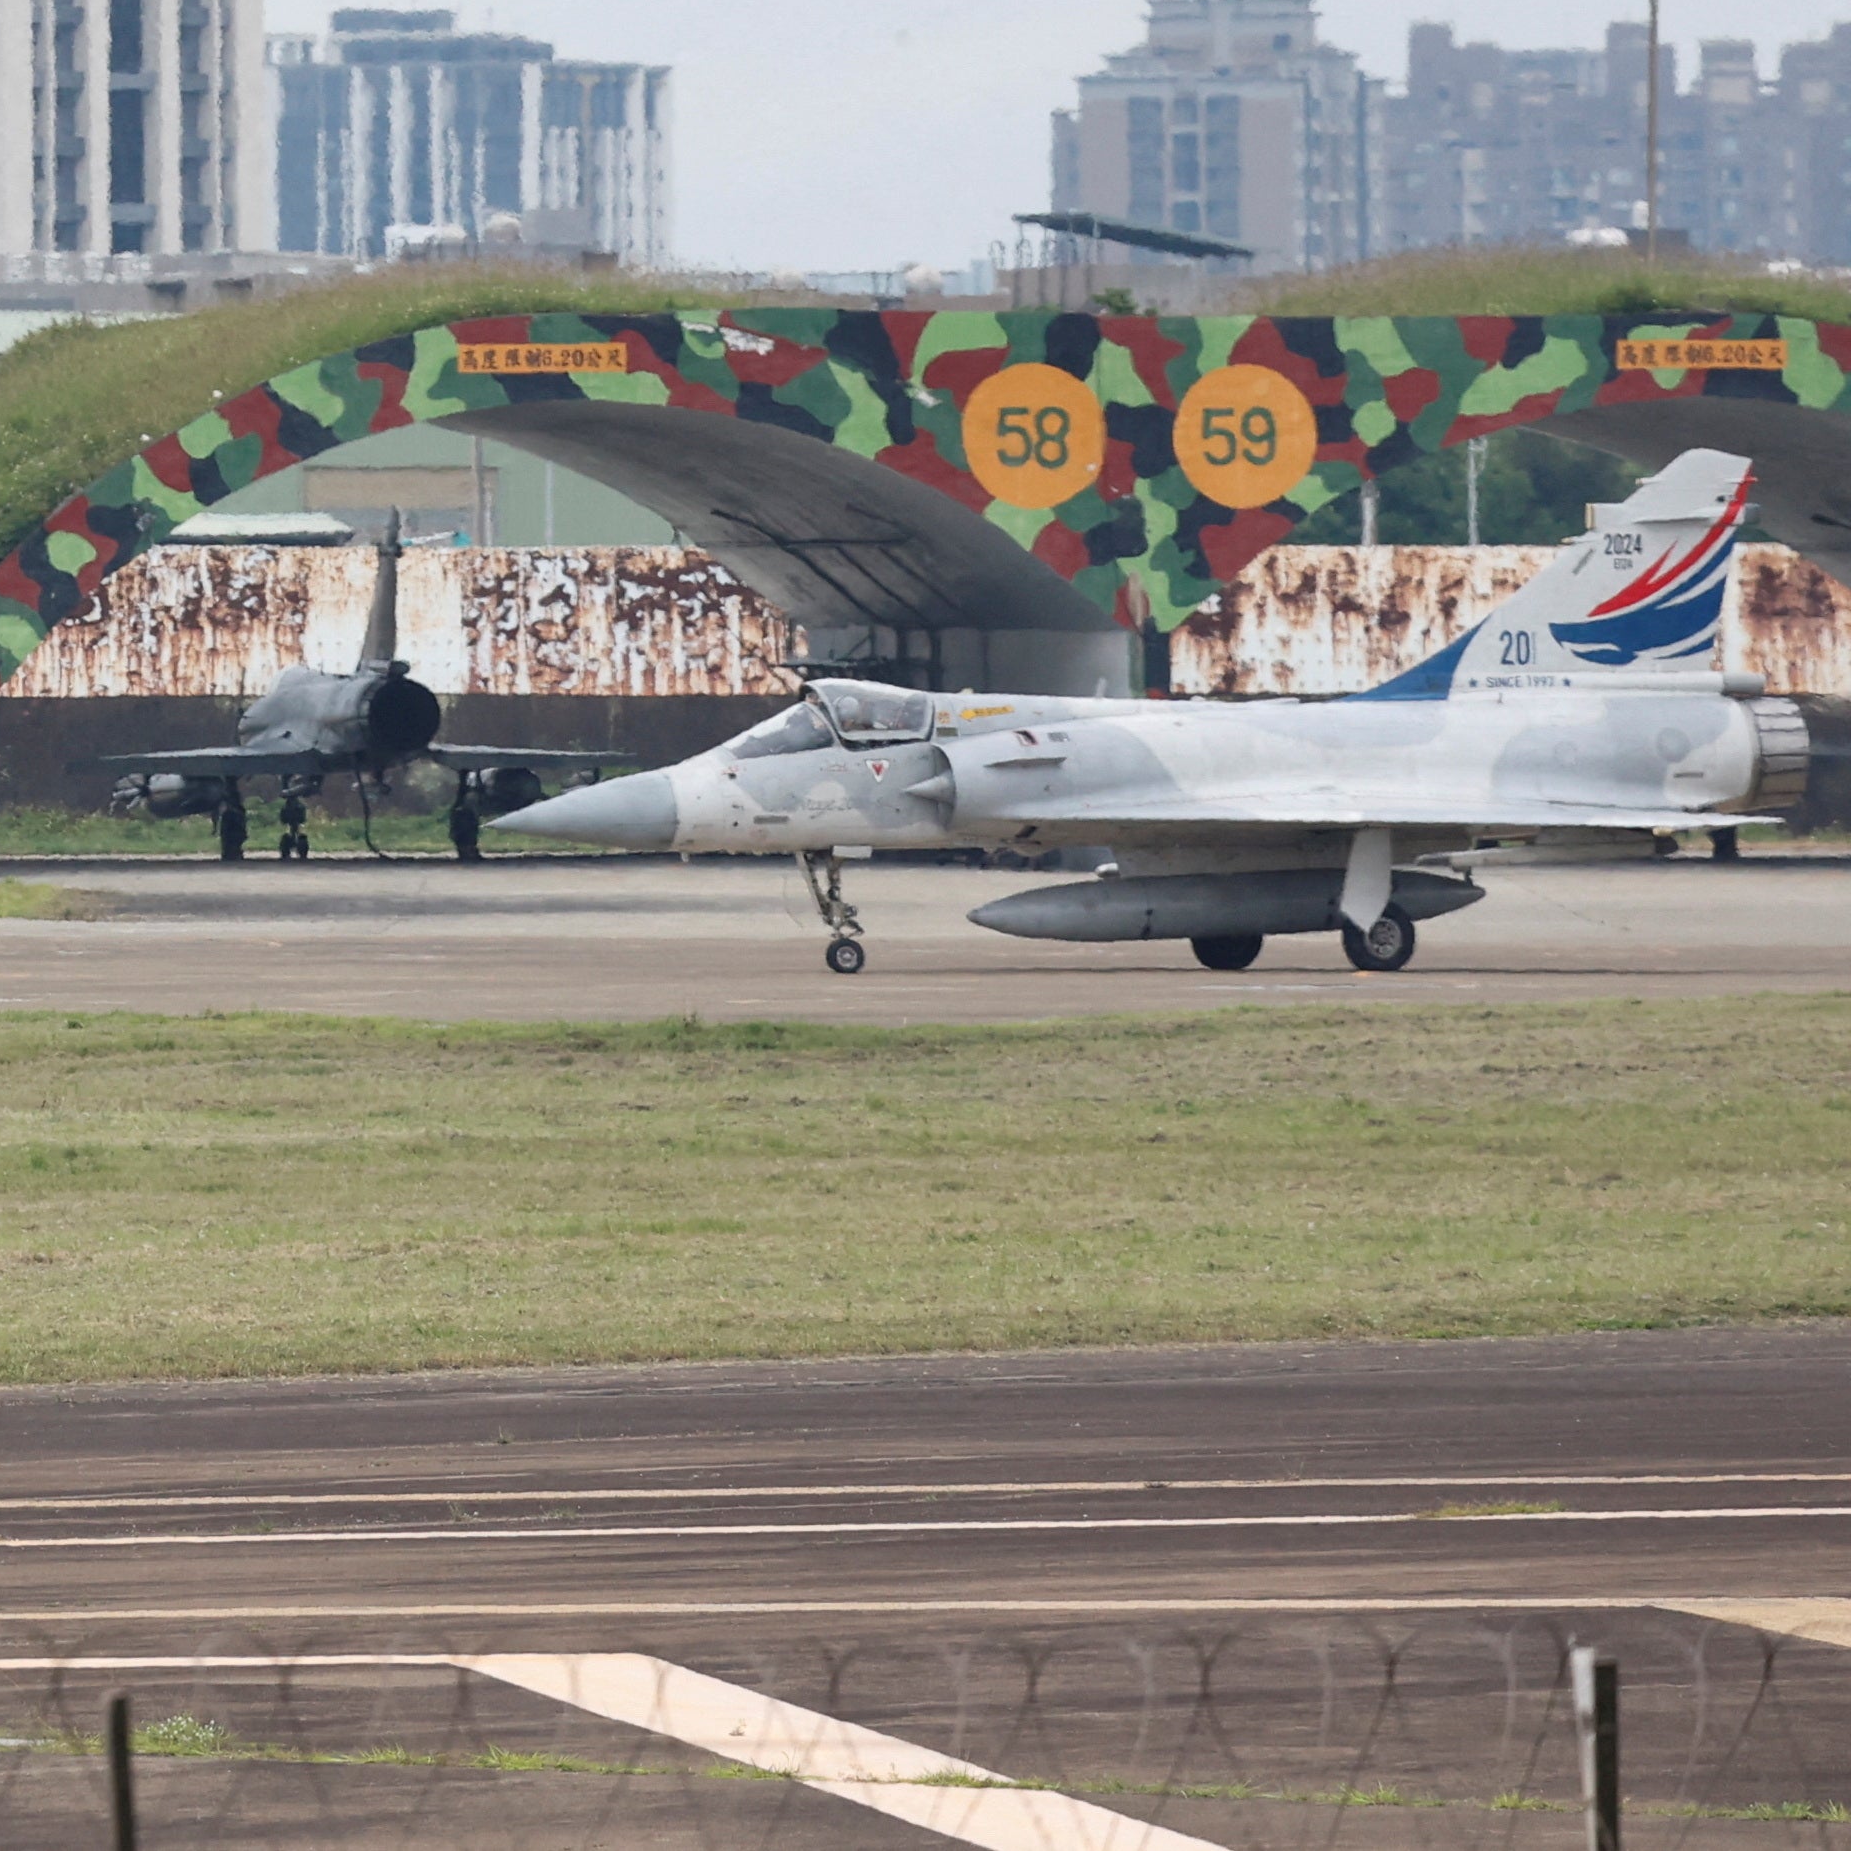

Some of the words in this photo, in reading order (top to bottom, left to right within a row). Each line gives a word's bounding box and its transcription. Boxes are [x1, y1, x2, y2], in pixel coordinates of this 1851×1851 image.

[996, 406, 1071, 469] 58
[1202, 406, 1276, 466] 59
[1604, 533, 1642, 555] 2024
[1499, 630, 1530, 665] 20
[1486, 676, 1521, 688] SINCE
